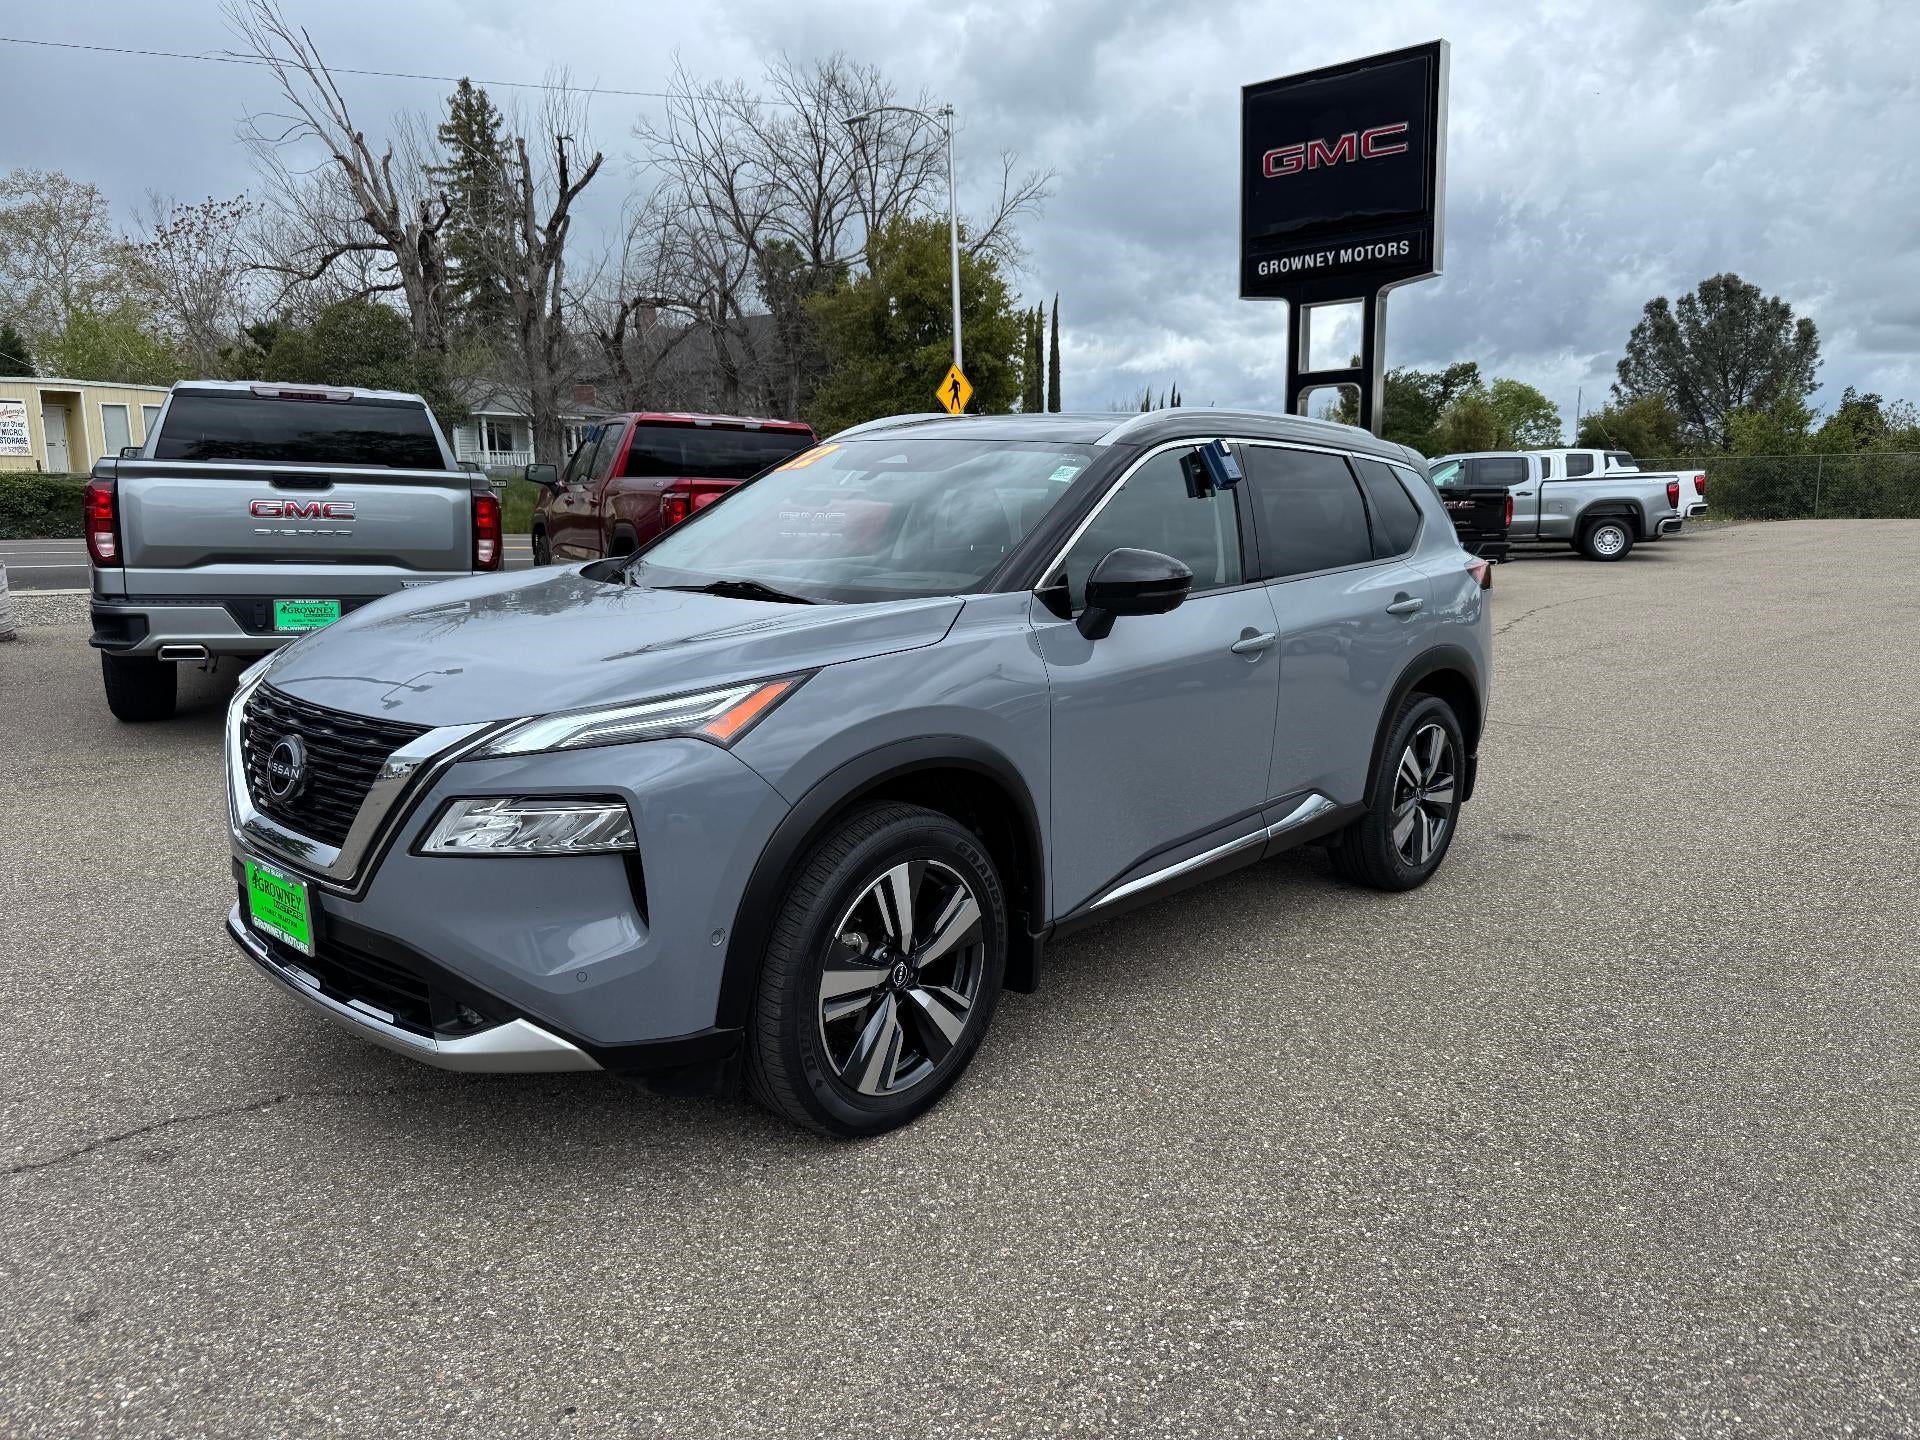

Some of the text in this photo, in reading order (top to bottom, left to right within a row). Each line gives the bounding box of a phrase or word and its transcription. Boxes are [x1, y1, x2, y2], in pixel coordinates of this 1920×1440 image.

[1262, 121, 1409, 178] GMC
[1258, 240, 1410, 276] GROWNEY MOTORS
[0, 436, 28, 444] STORAGE
[250, 499, 356, 521] GMC
[254, 528, 353, 537] SIERRA
[258, 877, 302, 911] GROWNEY
[253, 917, 283, 939] GROWNEY
[284, 931, 309, 954] MOTORS
